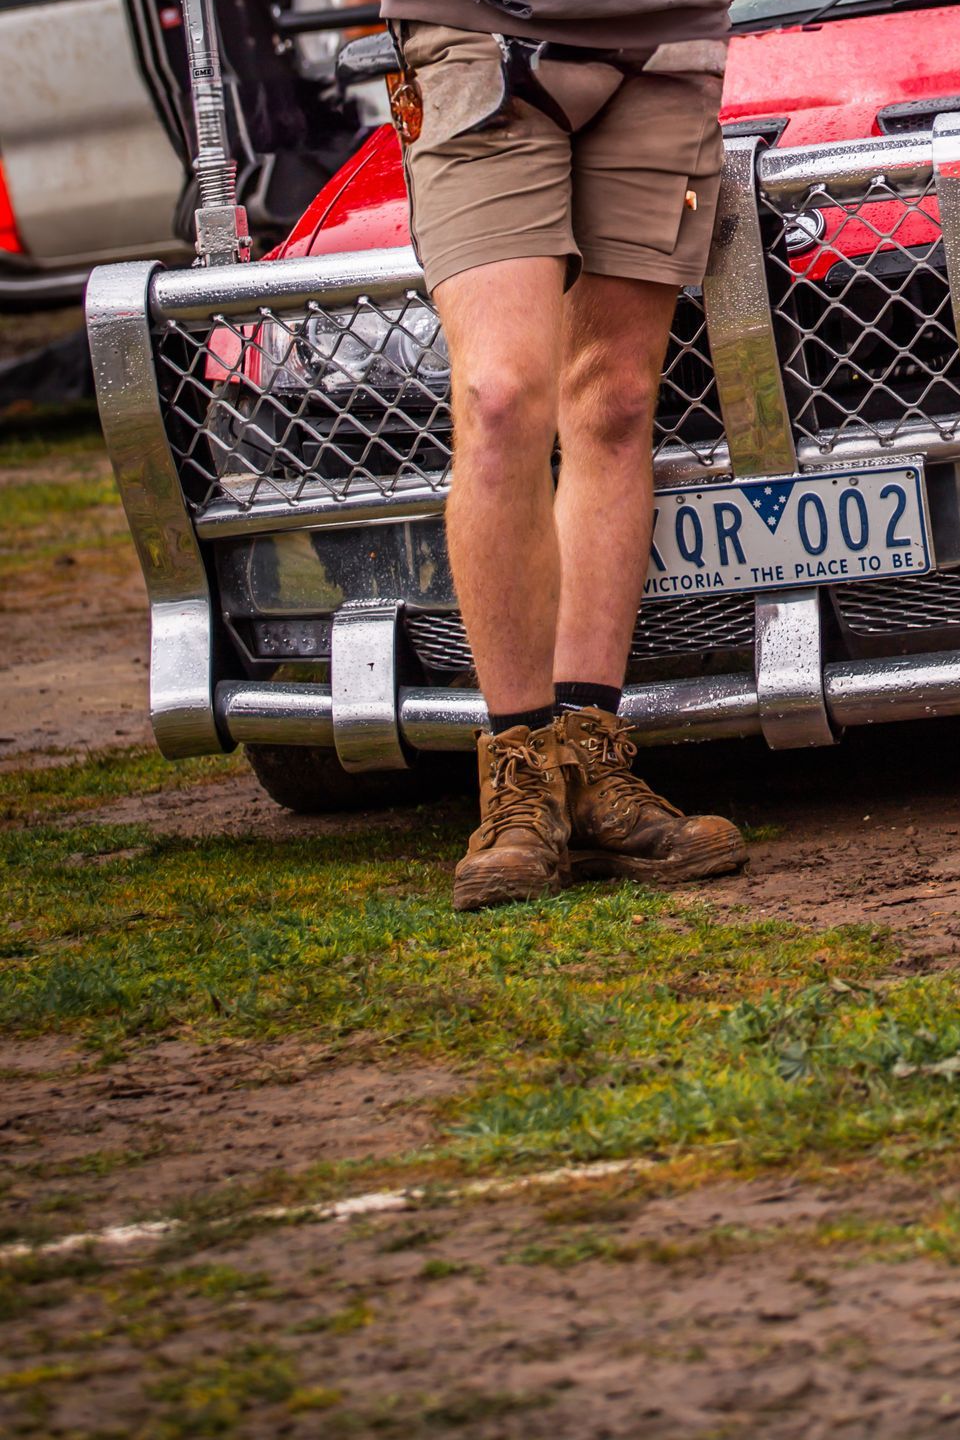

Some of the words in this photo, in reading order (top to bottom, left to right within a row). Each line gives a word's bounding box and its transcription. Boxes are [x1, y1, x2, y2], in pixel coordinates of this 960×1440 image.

[797, 483, 912, 556] 002
[643, 572, 725, 594] VICTORIA
[750, 566, 785, 583] THE
[794, 559, 849, 579] PLACE
[857, 555, 881, 572] TO
[892, 552, 914, 569] BE
